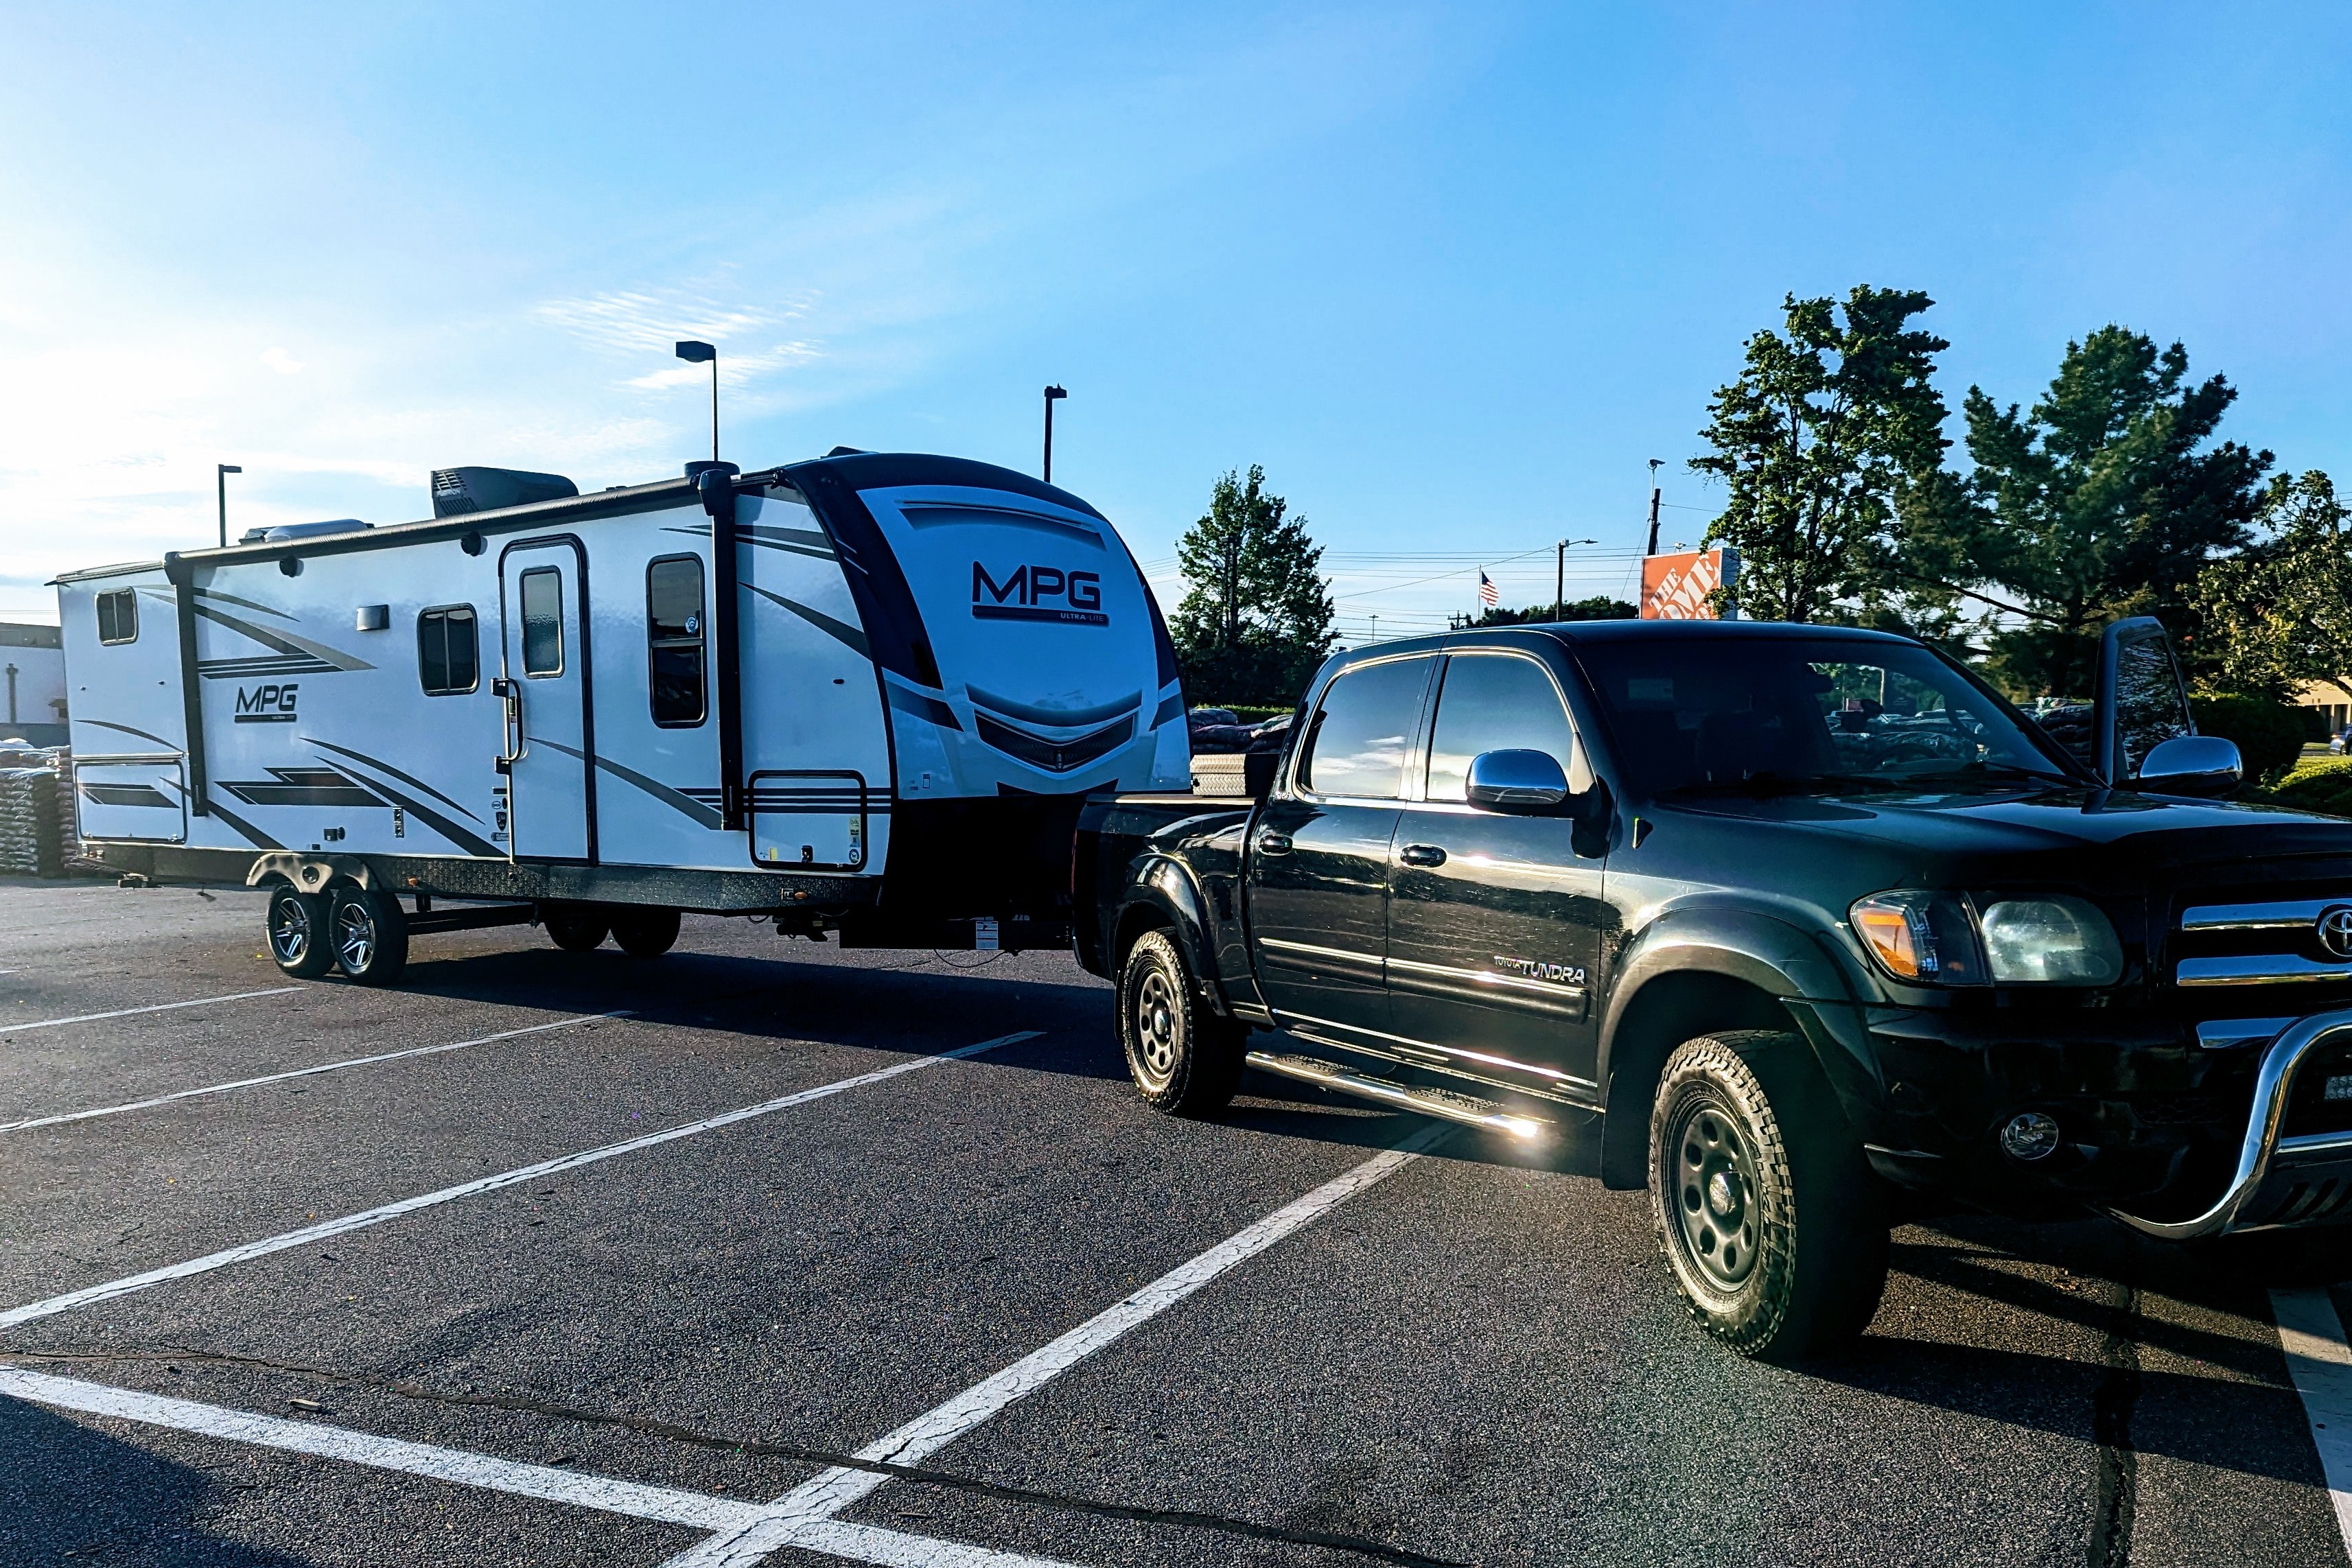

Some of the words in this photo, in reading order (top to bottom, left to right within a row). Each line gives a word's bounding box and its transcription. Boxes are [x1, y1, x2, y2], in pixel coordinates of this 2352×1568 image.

[972, 561, 1101, 611] MPG
[1649, 567, 1681, 612] THE
[1660, 553, 1720, 619] OME
[1060, 612, 1104, 622] ULTRA-LITE
[235, 684, 299, 712] MPG
[1494, 955, 1522, 969] TOYOTA
[1520, 961, 1585, 985] TUNDRA
